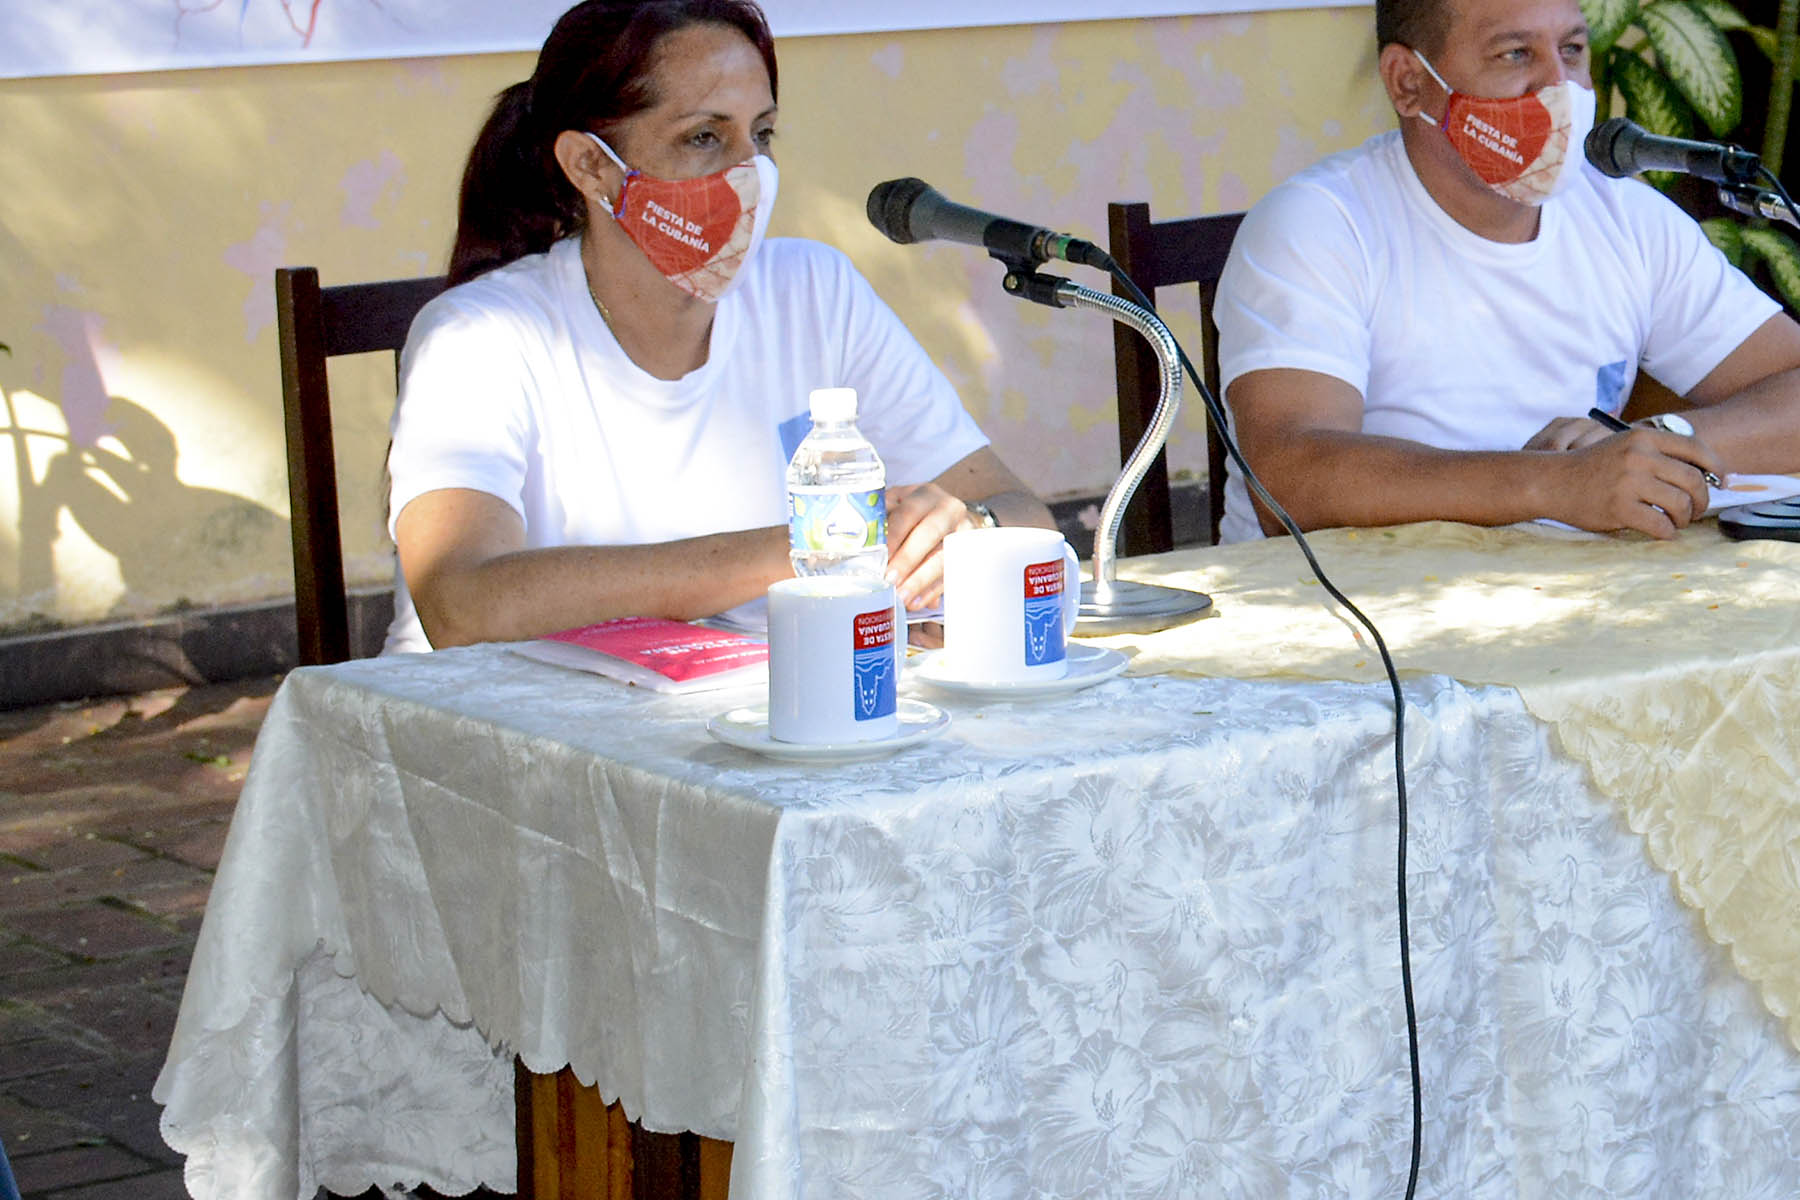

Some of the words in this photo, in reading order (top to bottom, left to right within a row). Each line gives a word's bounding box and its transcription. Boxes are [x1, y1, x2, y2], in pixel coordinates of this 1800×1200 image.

[1463, 124, 1477, 140] LA
[1479, 135, 1524, 165] CUBANÍA
[1466, 113, 1500, 140] FIESTA
[1500, 133, 1518, 149] DE
[641, 211, 657, 228] LA
[658, 222, 710, 253] CUBANÍA
[646, 200, 685, 228] FIESTA
[685, 221, 703, 236] DE
